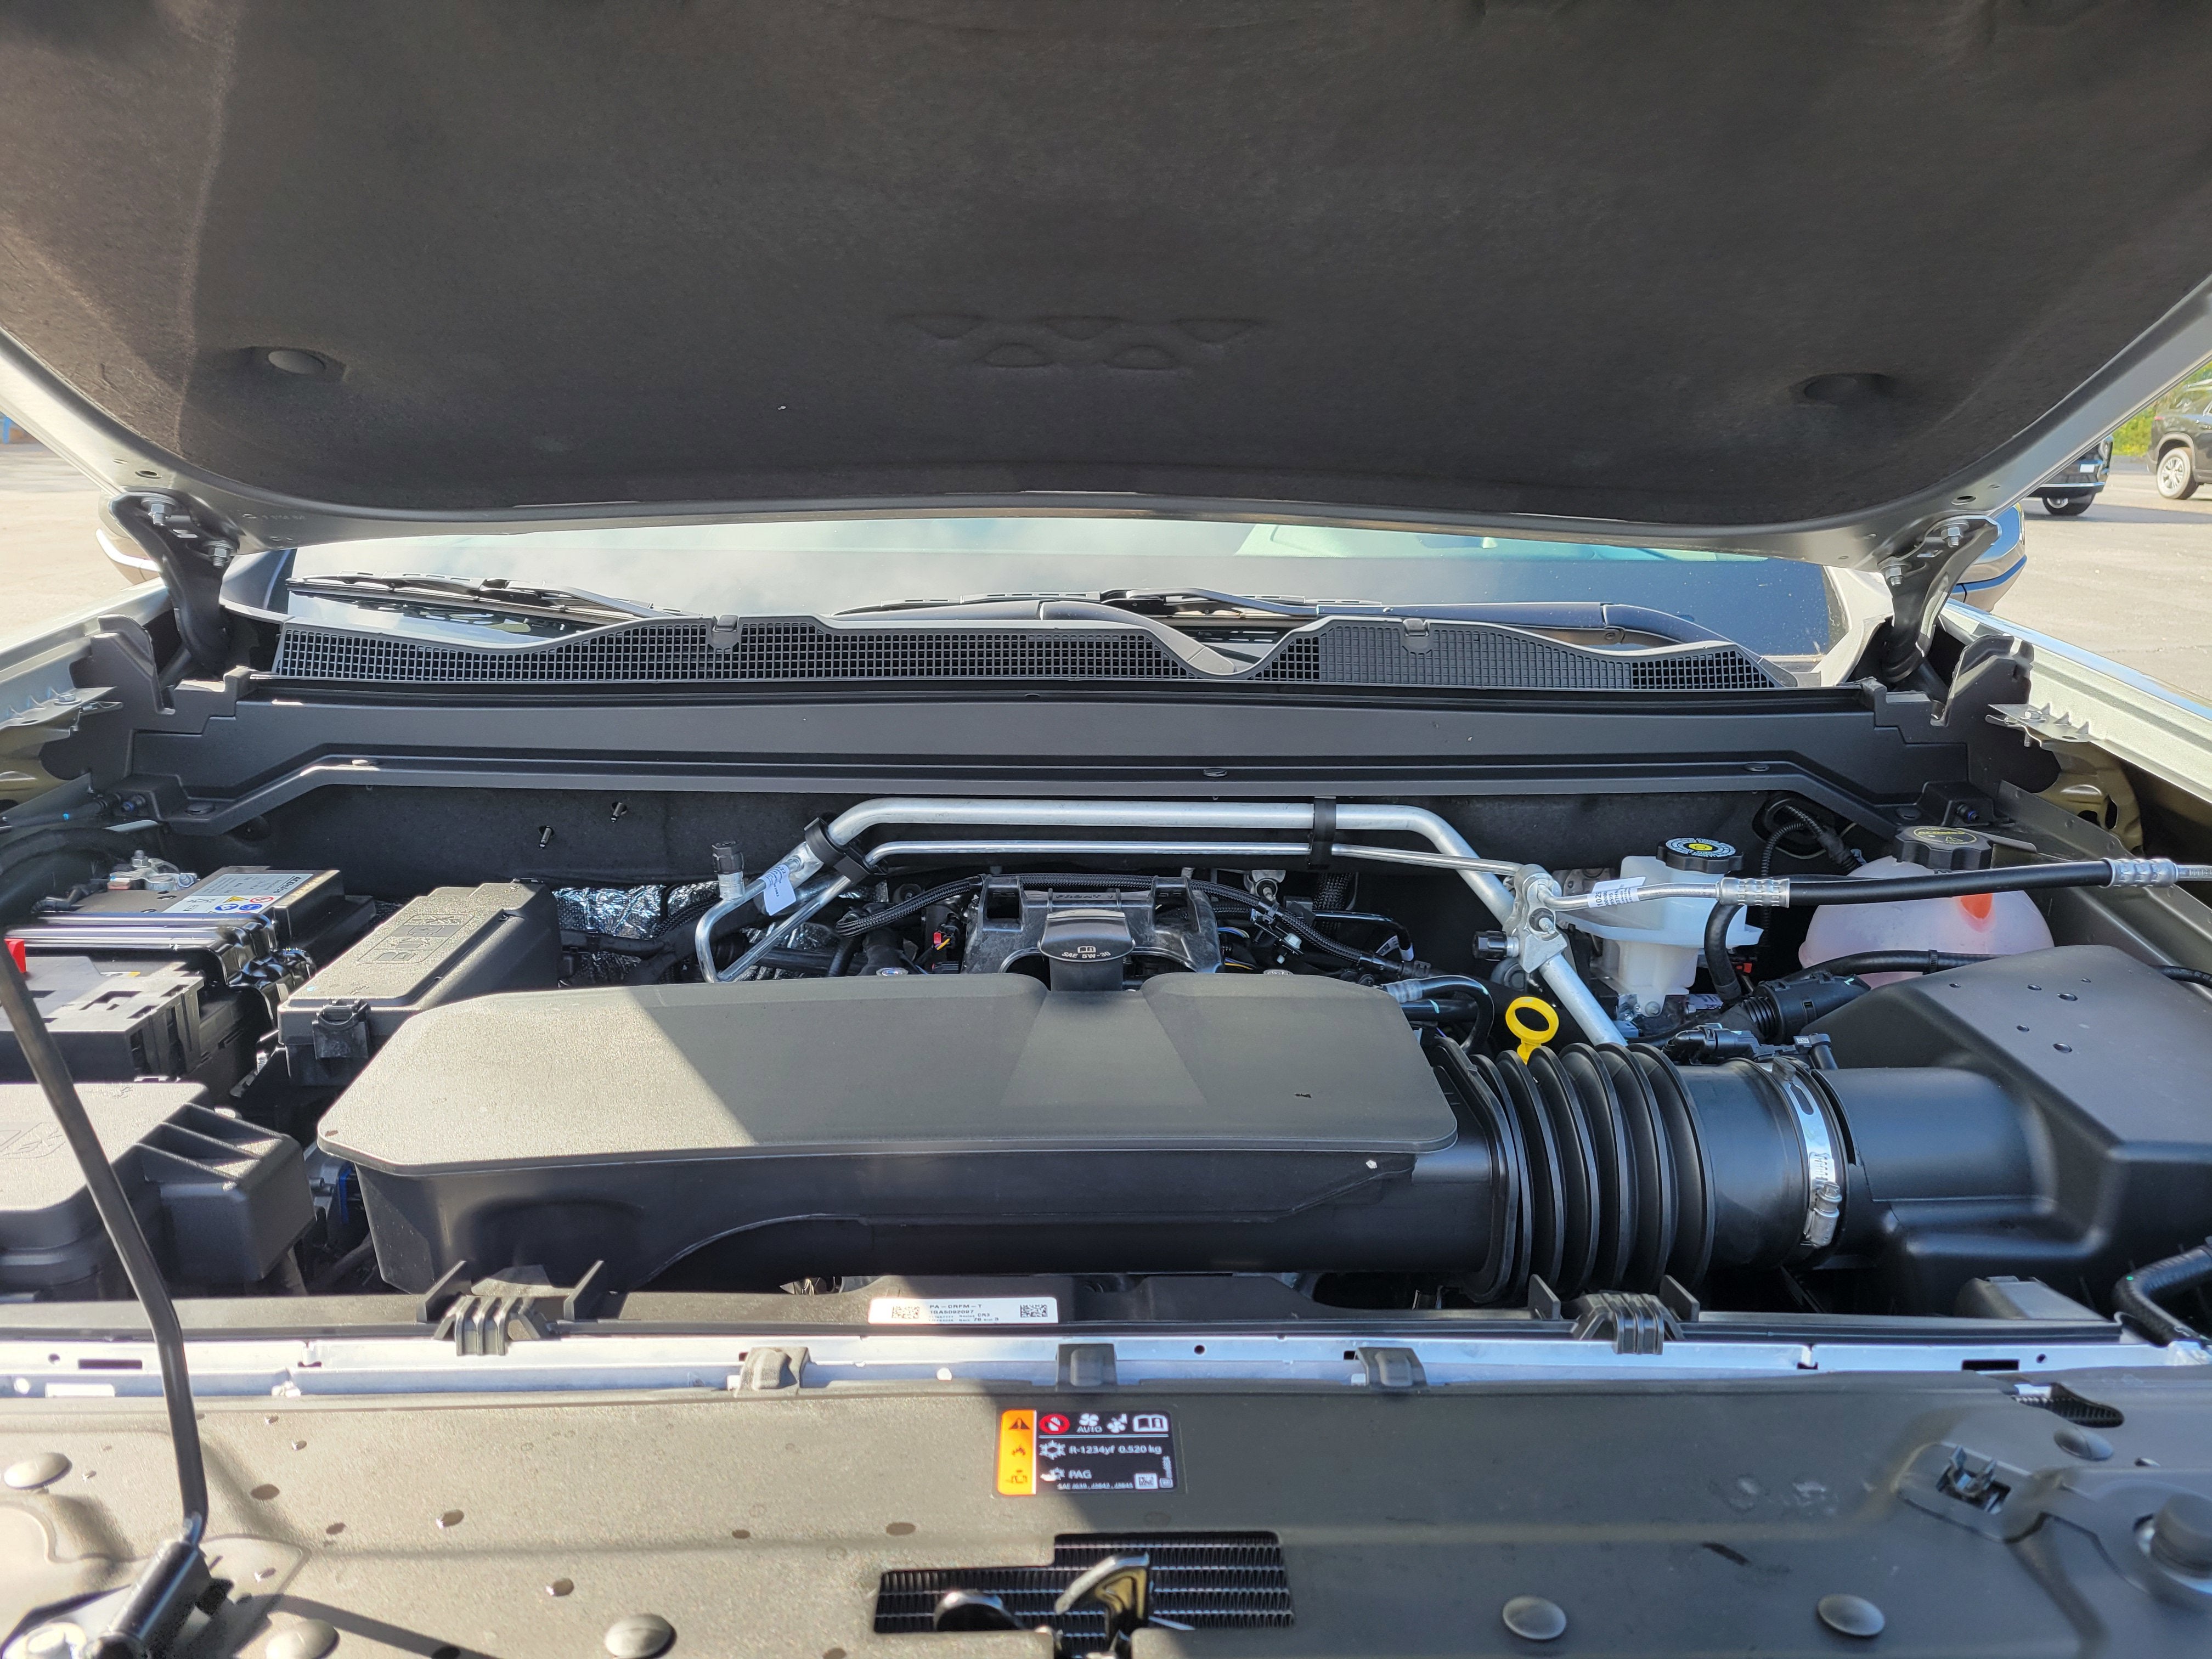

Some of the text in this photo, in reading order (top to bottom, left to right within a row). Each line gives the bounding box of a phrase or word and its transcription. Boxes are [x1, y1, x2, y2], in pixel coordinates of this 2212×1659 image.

[273, 876, 302, 894] ACDelco
[1069, 1444, 1162, 1455] R-1234yf 0.520 kg
[1068, 1470, 1092, 1479] PAG
